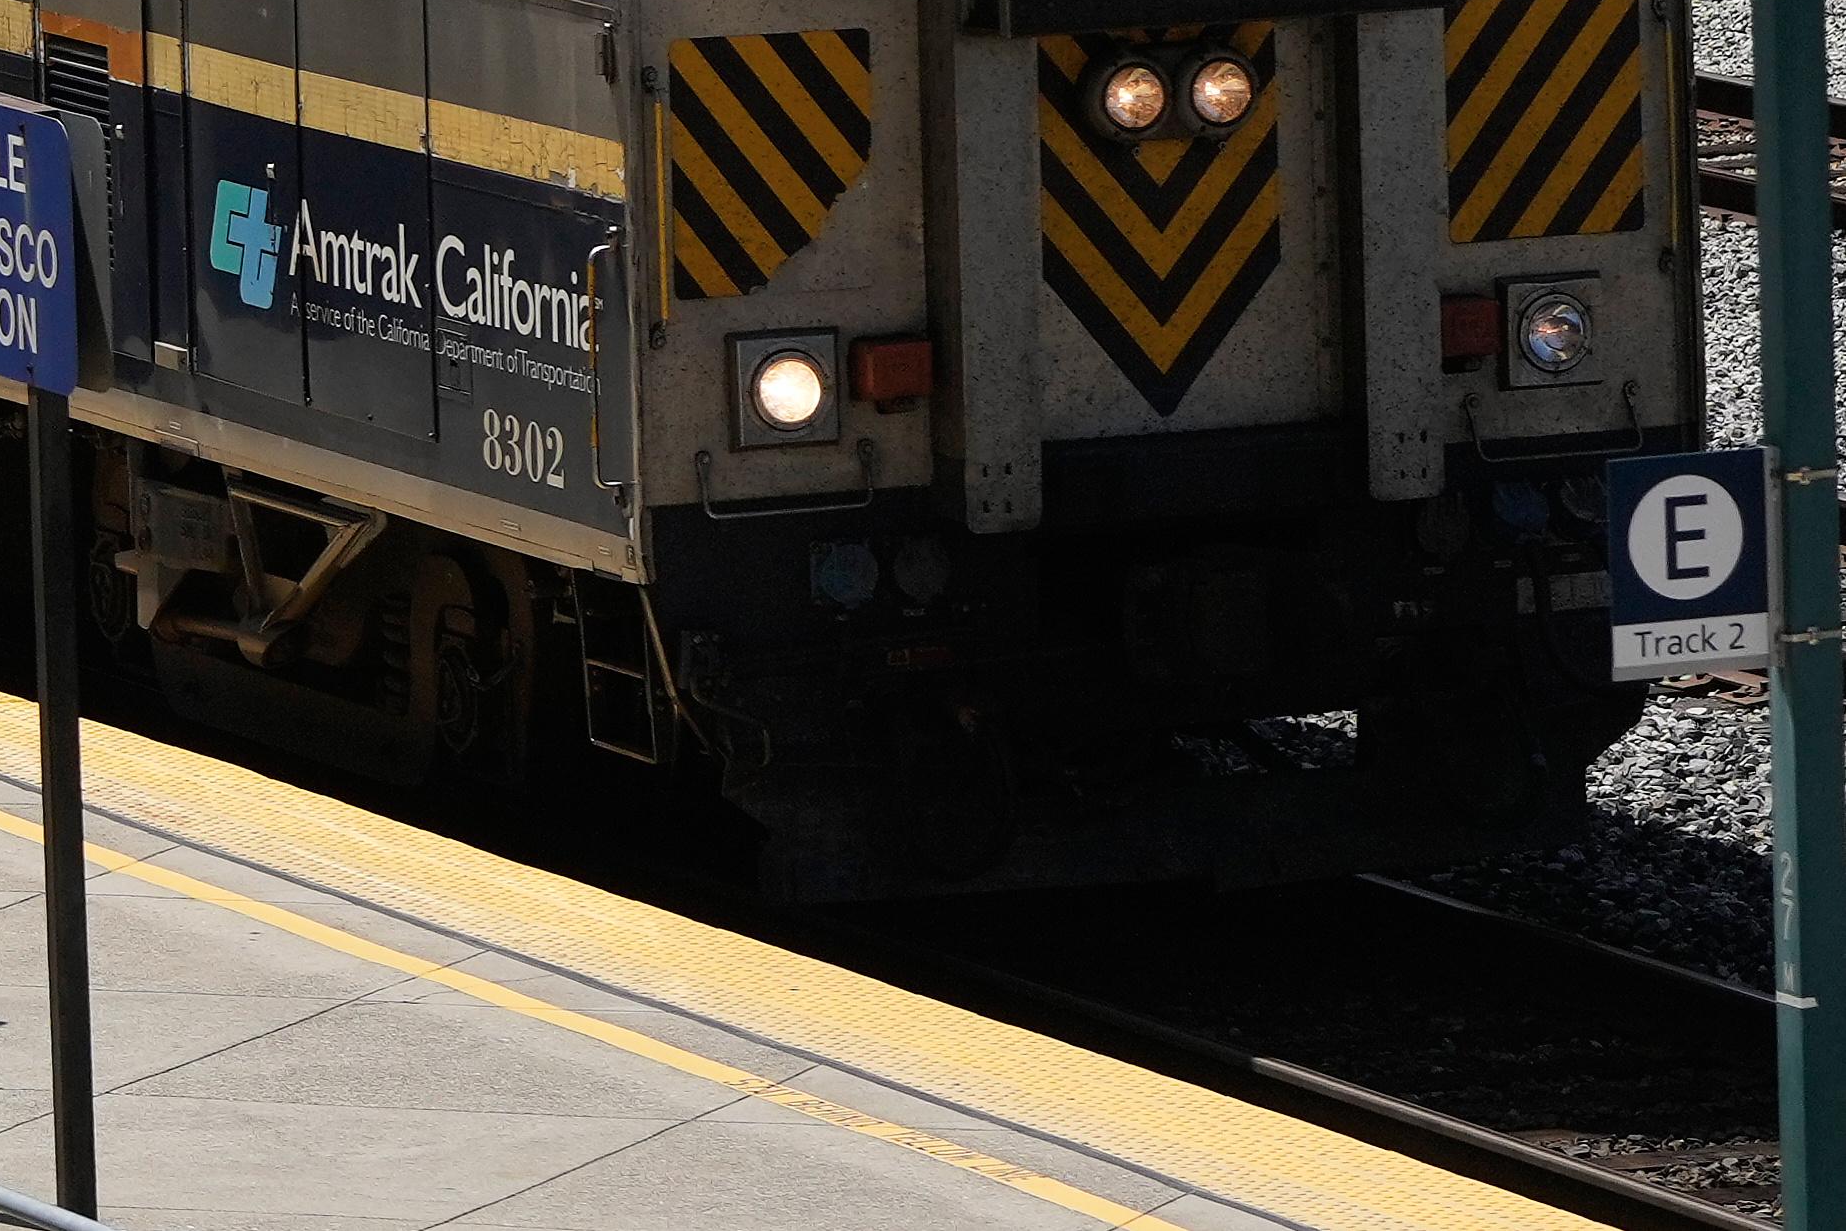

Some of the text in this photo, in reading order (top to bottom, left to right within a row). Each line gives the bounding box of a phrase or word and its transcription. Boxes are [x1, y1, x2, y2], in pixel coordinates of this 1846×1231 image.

[288, 198, 423, 309] Amtrak
[435, 234, 600, 353] California
[290, 291, 601, 396] A service of the California Department of Transportation
[482, 408, 565, 490] 8302
[1664, 493, 1711, 581] E
[1634, 622, 1746, 658] Track 2
